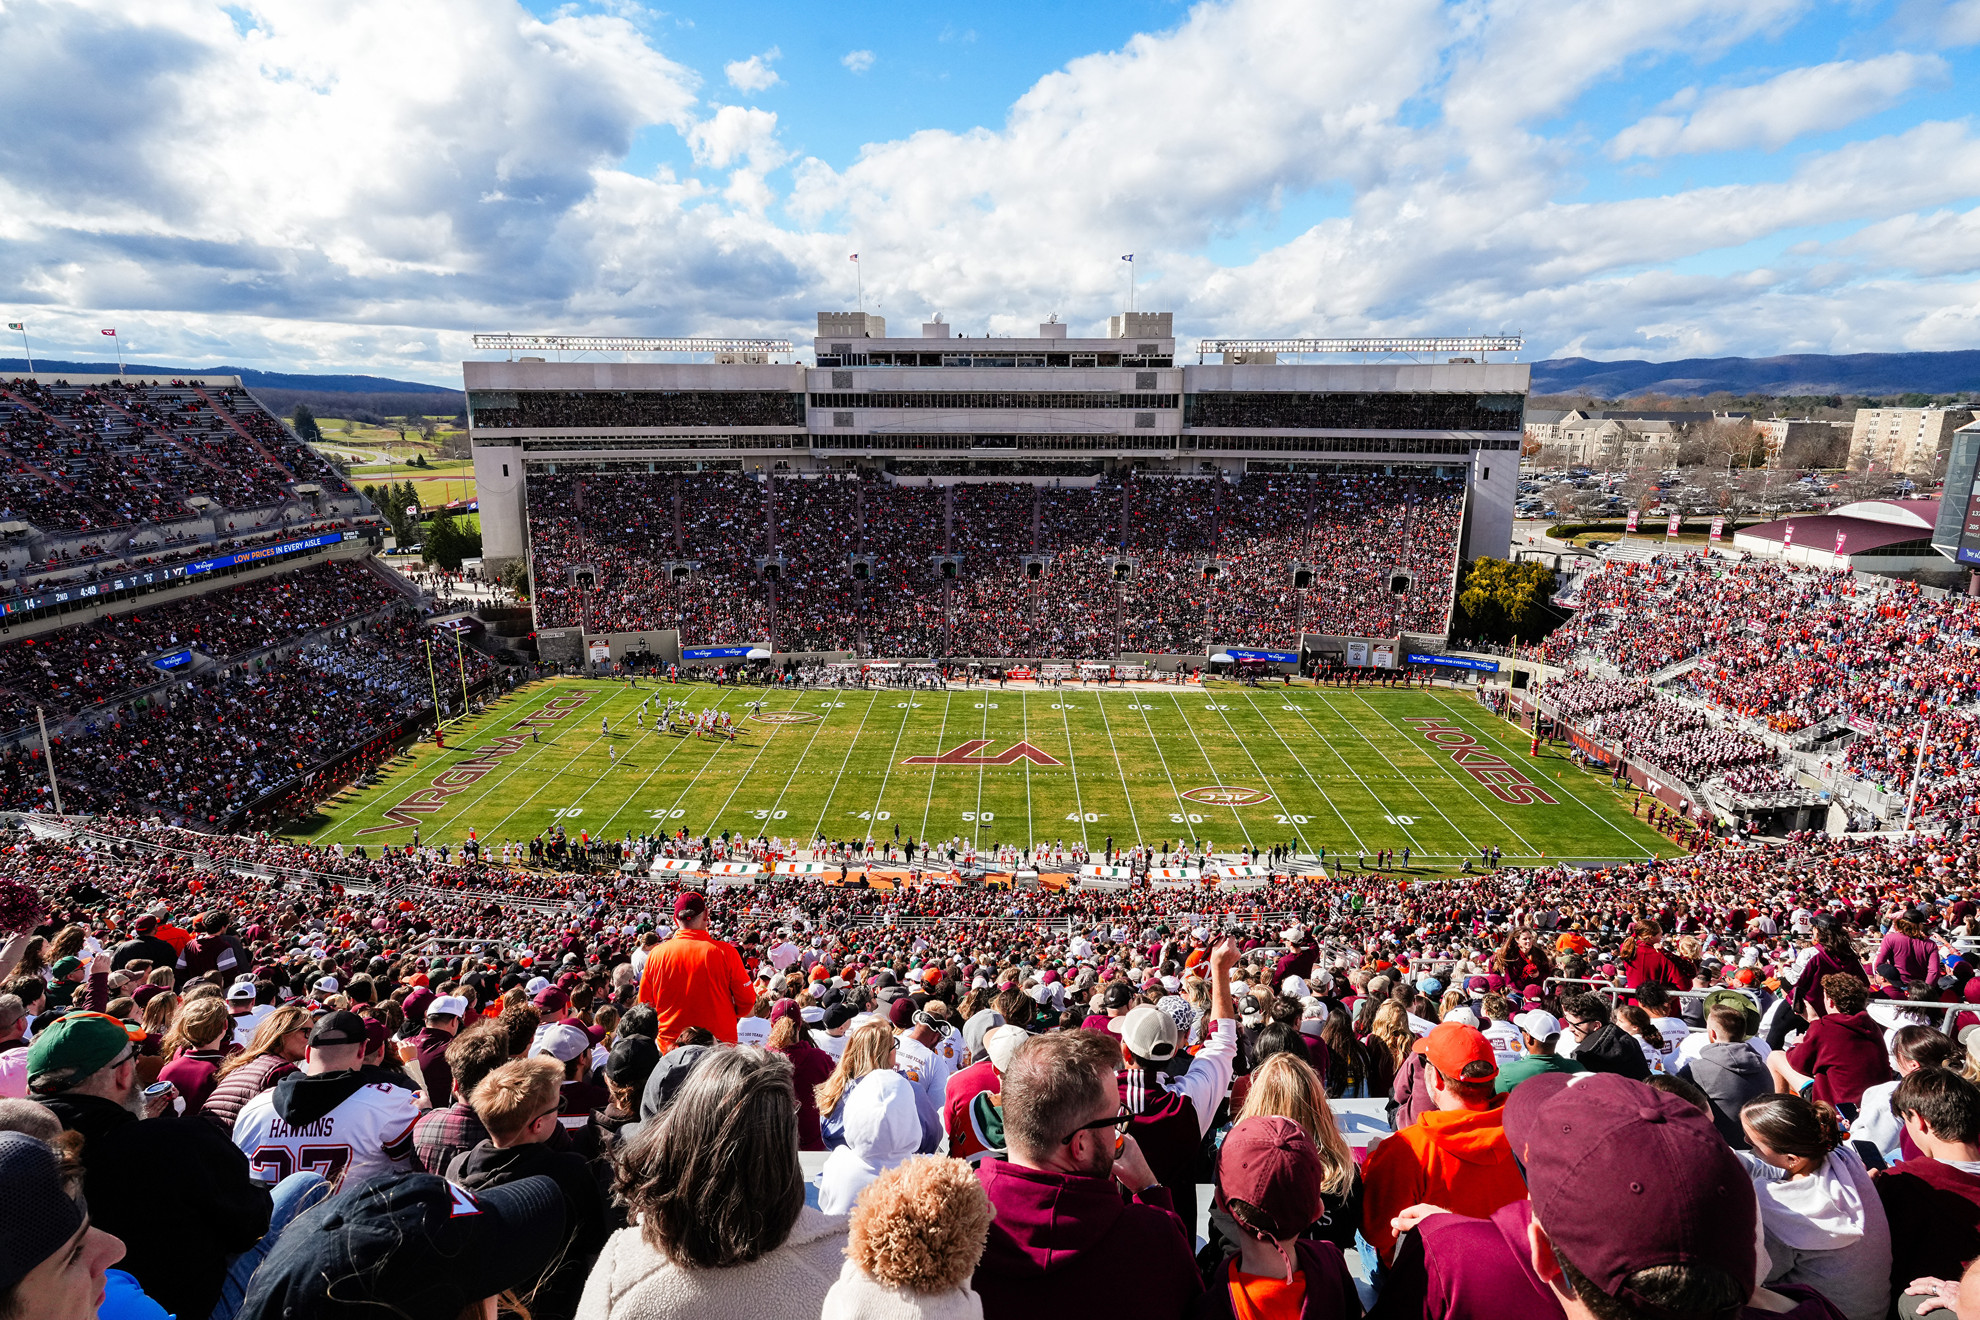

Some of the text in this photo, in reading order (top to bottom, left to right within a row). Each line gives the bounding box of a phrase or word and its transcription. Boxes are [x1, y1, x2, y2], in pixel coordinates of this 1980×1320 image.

[1670, 522, 1677, 531] 10
[1712, 526, 1722, 535] 25
[234, 538, 321, 564] LOW PRICES IN EVERY AISLE
[1836, 542, 1842, 551] 7
[164, 570, 169, 579] 3
[56, 592, 68, 602] 2ND
[80, 586, 96, 597] 4:49
[25, 599, 35, 610] 14
[363, 726, 404, 753] HOKIES
[1572, 734, 1610, 764] HOKIES
[352, 689, 602, 837] VIRGINIA TECH
[1402, 717, 1561, 805] HOKIES
[1647, 777, 1662, 794] VT
[554, 808, 584, 818] 10
[649, 808, 686, 819] 20
[752, 810, 788, 820] 30
[857, 811, 891, 820] 40
[961, 811, 995, 822] 50
[1065, 812, 1098, 822] 40
[1168, 814, 1203, 824] 30
[1273, 814, 1309, 825] 20
[1384, 815, 1414, 825] 10
[269, 1118, 334, 1138] HAWKINS
